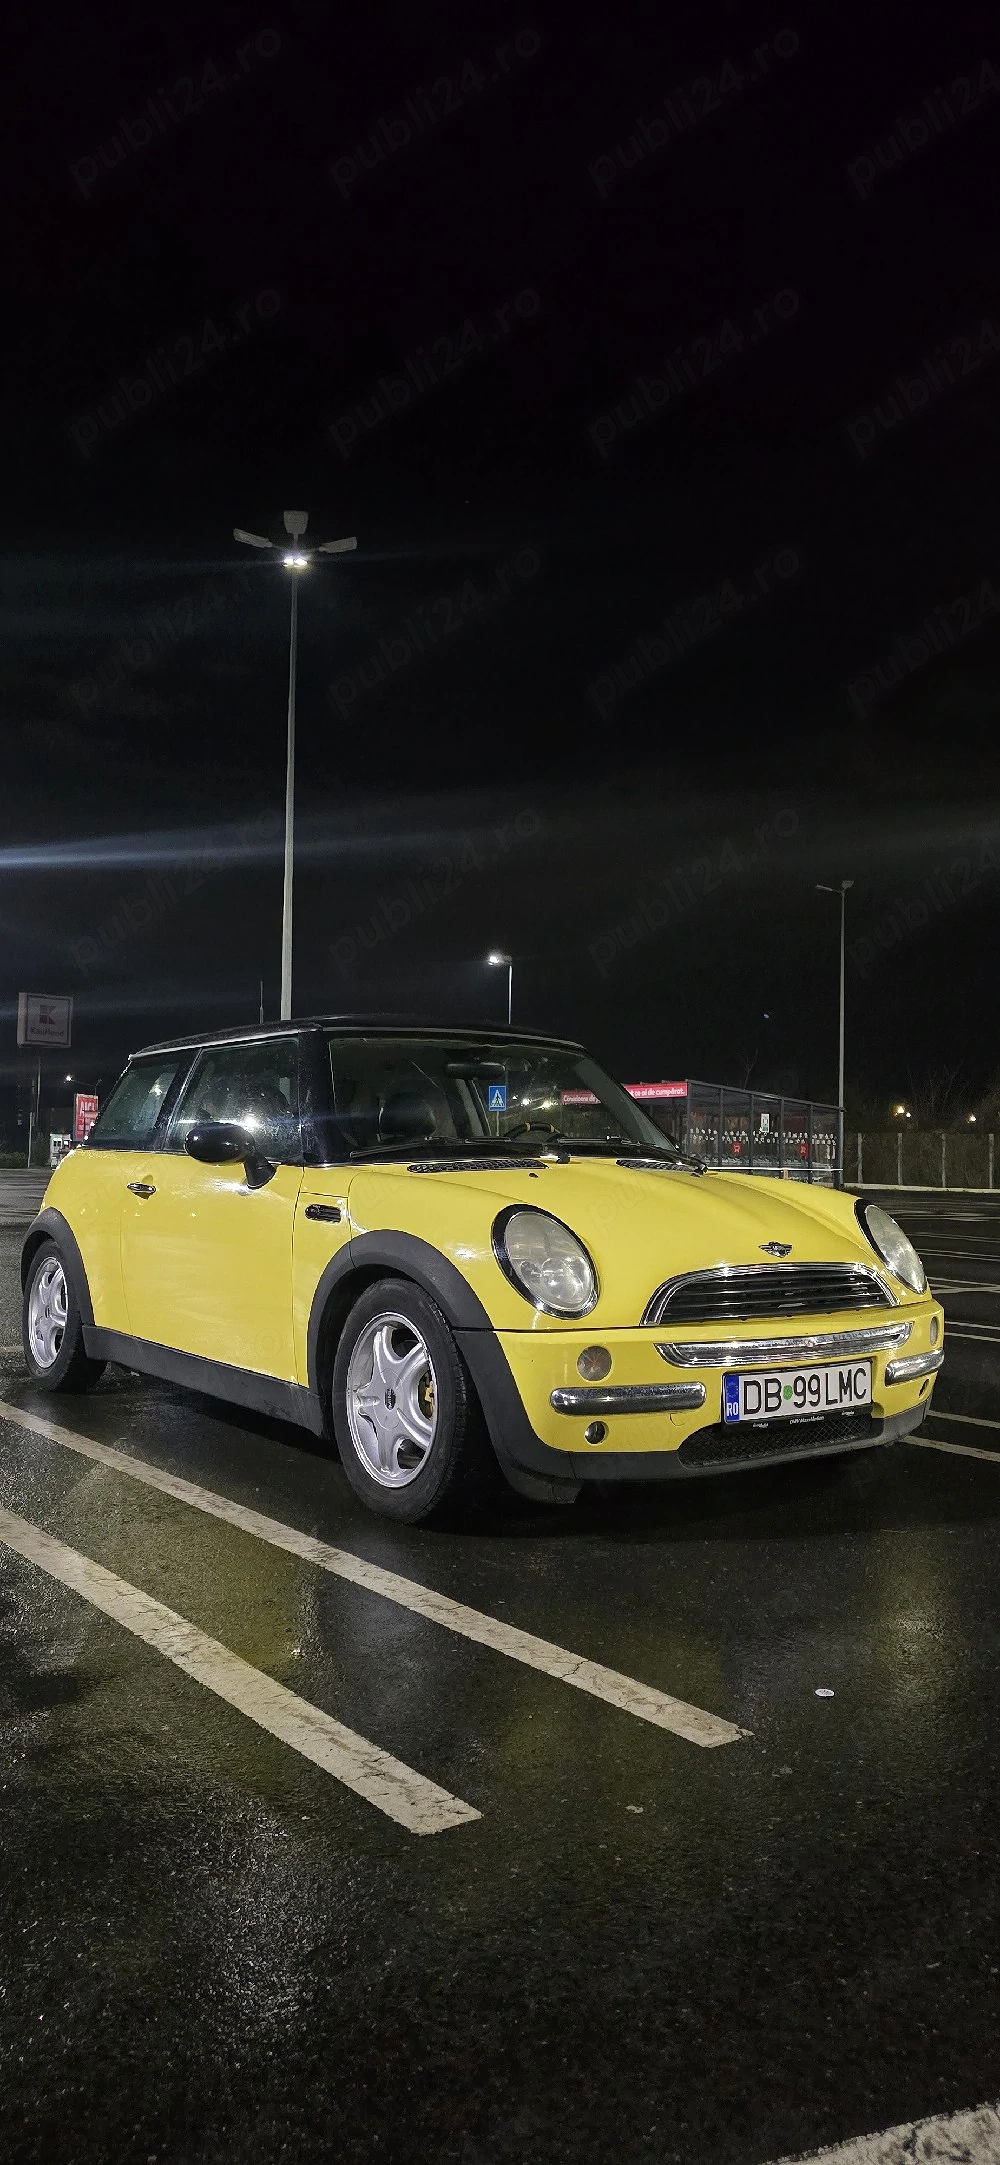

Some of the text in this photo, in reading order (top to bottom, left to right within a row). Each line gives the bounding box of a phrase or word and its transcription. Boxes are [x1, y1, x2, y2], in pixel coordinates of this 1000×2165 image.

[30, 1027, 64, 1037] Kaufland
[744, 1367, 867, 1415] DB 99 LMC
[726, 1401, 738, 1416] RO
